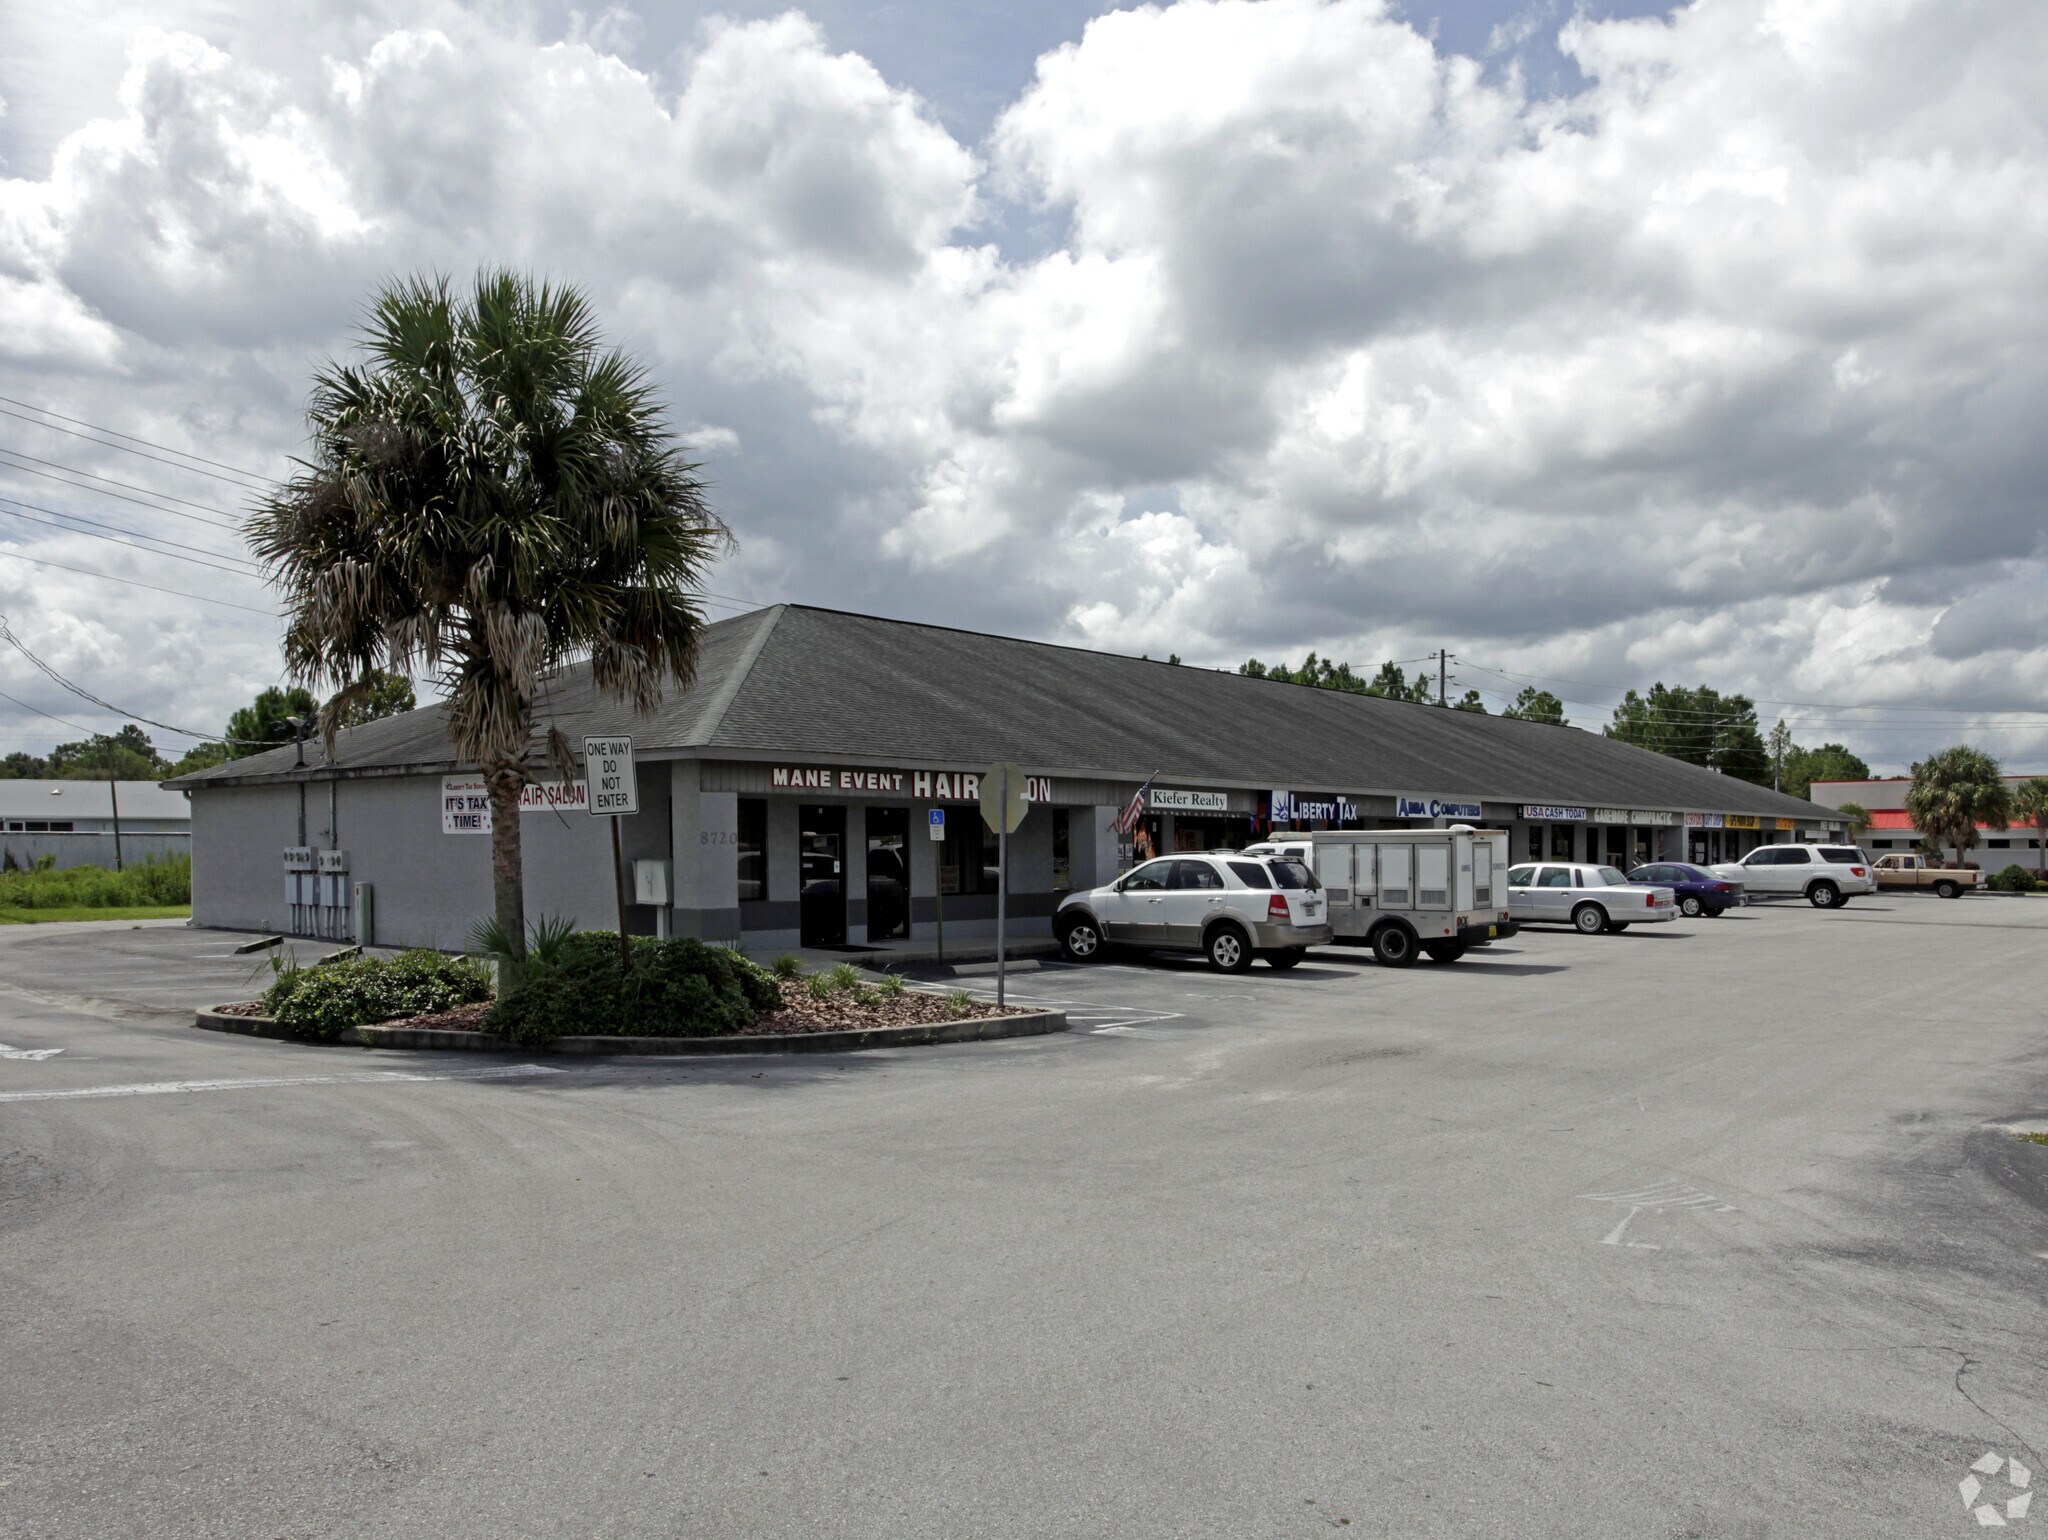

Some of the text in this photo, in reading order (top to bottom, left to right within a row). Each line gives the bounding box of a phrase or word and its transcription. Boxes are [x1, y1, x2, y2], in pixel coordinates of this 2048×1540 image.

[587, 742, 629, 756] ONE WAY
[603, 760, 617, 773] DO
[602, 776, 620, 790] NOT
[772, 768, 980, 800] MANE EVENT HAIR
[519, 785, 585, 805] AIR SALON
[598, 793, 629, 807] ENTER
[1153, 791, 1226, 809] Kiefer Realty
[446, 797, 489, 810] IT'S TAX
[1290, 793, 1357, 820] LIBERTY TAX
[1398, 798, 1481, 819] ABBA COMPUTERS
[1526, 806, 1544, 817] USA
[1544, 807, 1564, 818] CASH
[1565, 808, 1586, 819] TODAY
[453, 815, 481, 828] TIME!
[700, 831, 738, 846] 8720
